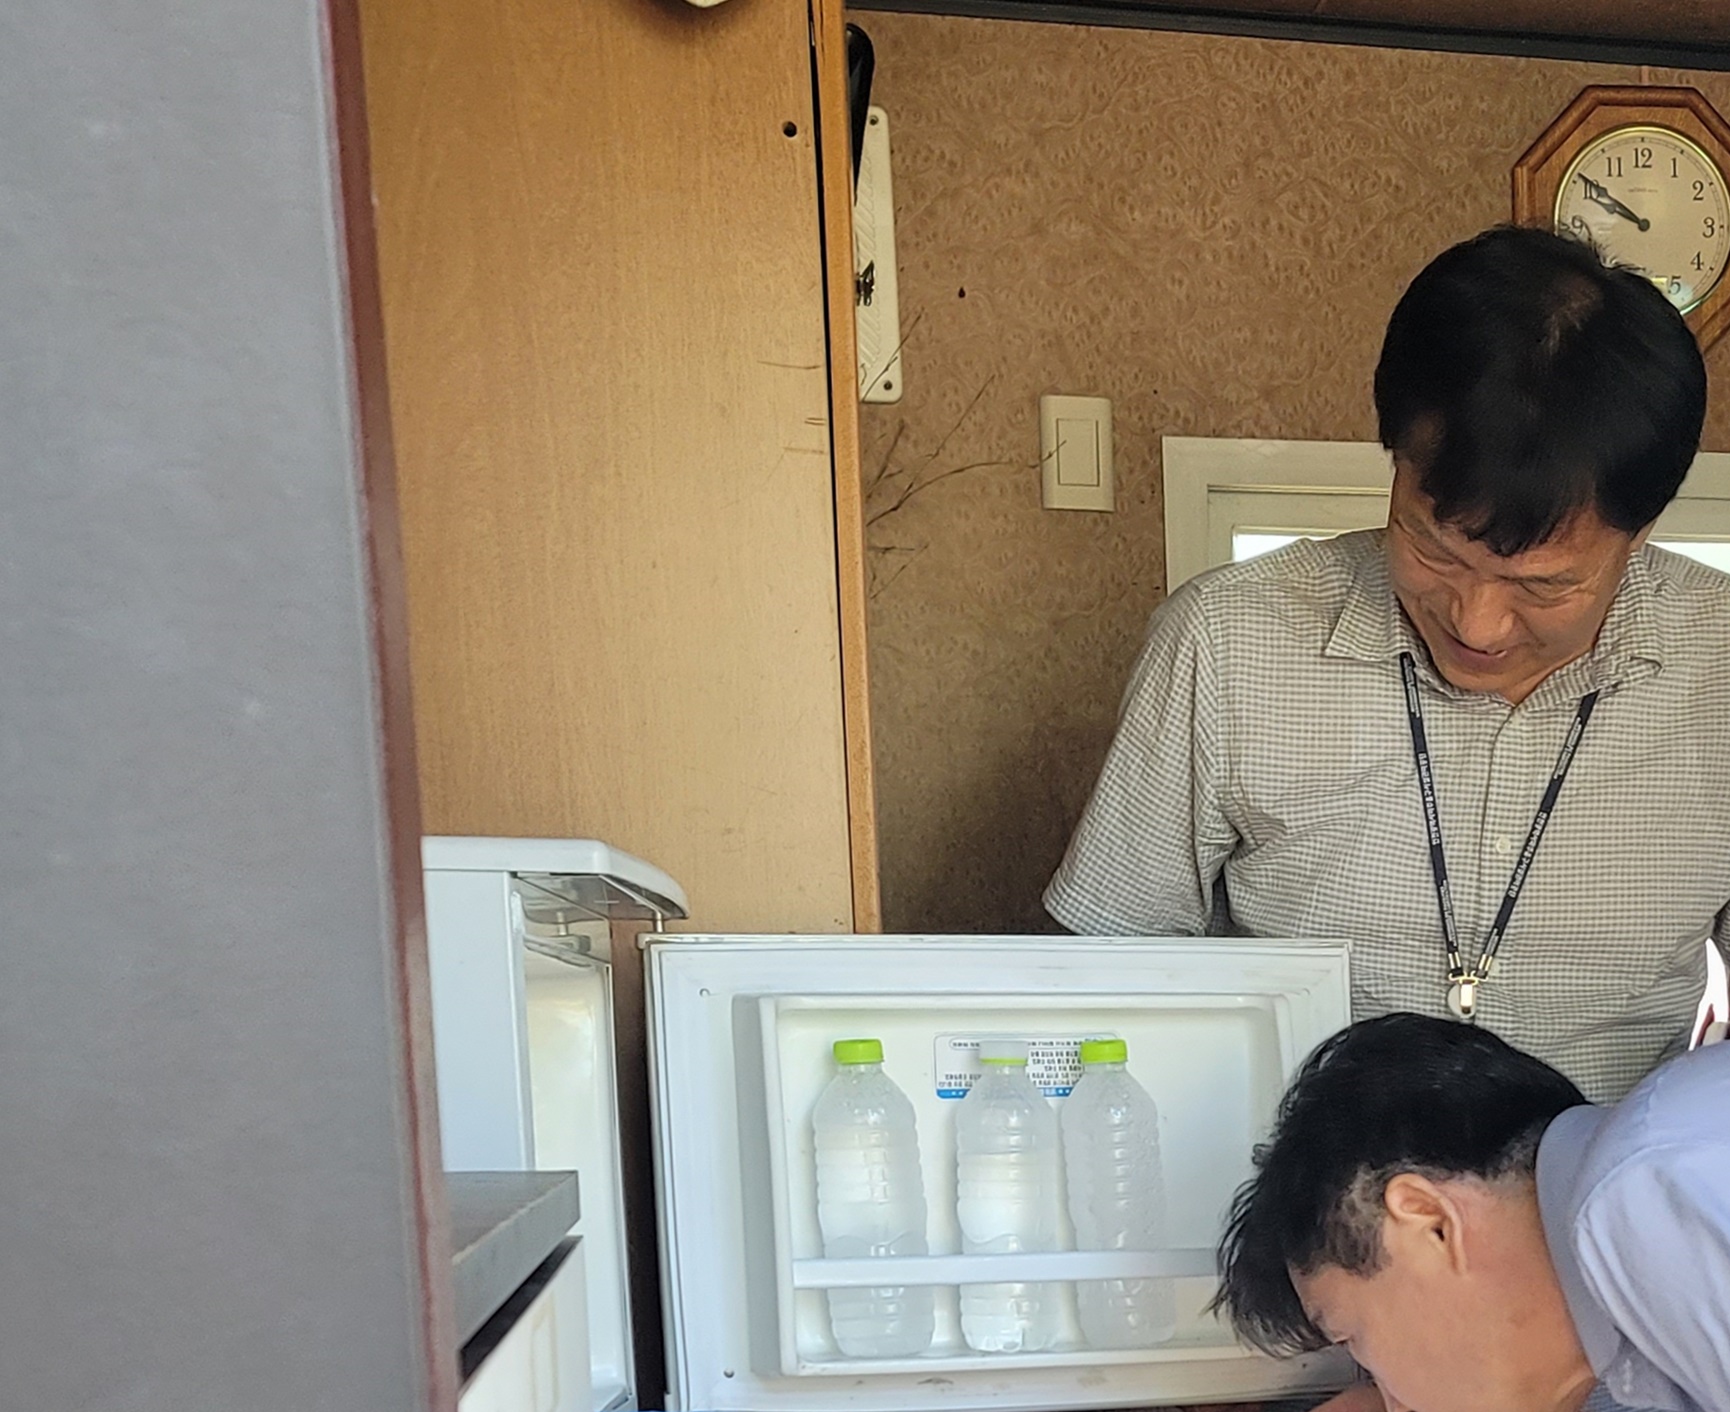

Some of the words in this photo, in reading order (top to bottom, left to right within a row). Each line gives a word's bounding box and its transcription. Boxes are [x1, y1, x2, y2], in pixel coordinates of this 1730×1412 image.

[1606, 156, 1623, 178] 11
[1633, 147, 1653, 169] 12
[1670, 157, 1679, 178] 1
[1691, 180, 1705, 201] 2
[1702, 217, 1715, 238] 3
[1690, 251, 1705, 271] 4
[1667, 275, 1682, 295] 5
